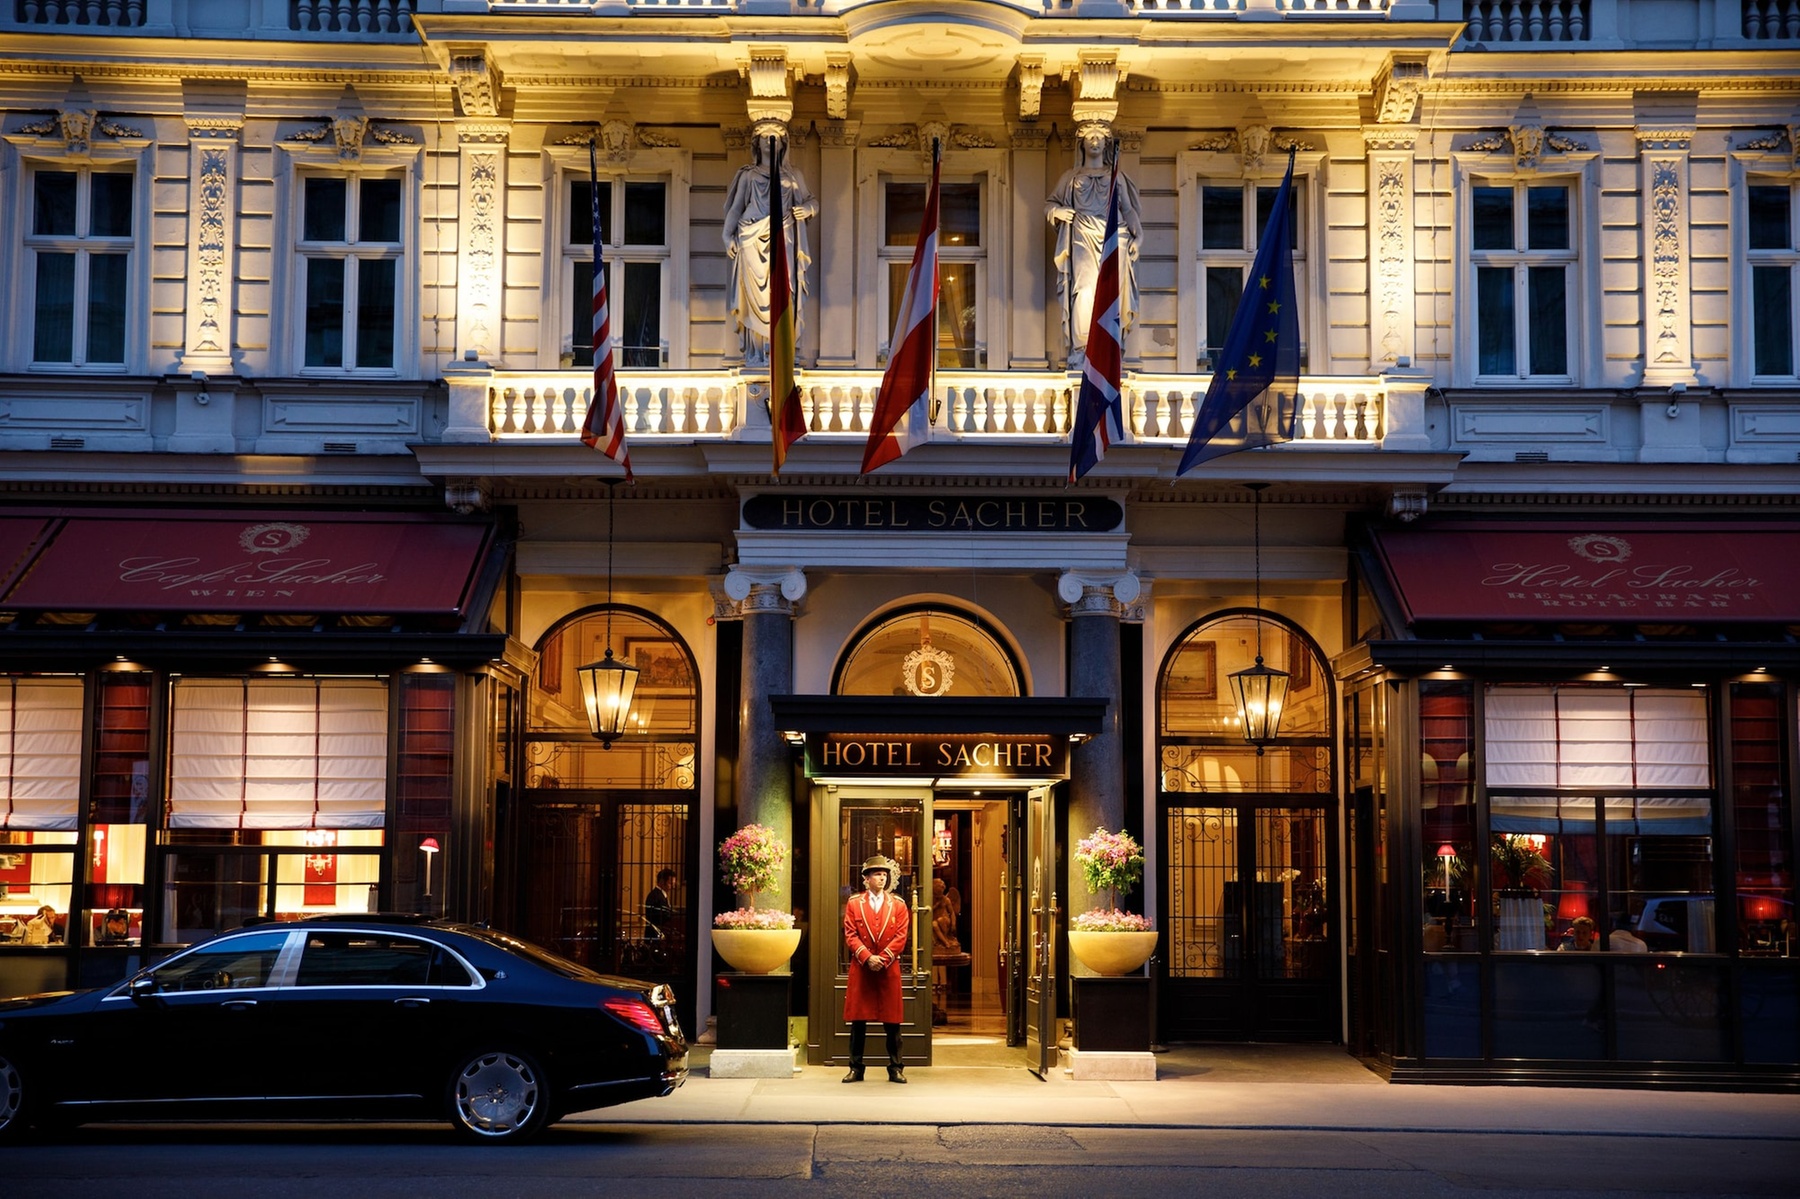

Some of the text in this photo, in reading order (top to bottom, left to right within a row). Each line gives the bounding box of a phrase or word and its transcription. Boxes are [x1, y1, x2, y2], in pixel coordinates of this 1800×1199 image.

[781, 499, 1089, 528] HOTEL SACHER
[261, 532, 282, 546] S
[1592, 543, 1612, 556] S
[118, 556, 388, 590] Café Sacher
[1481, 562, 1765, 590] Hotel Sacher
[190, 589, 297, 598] WIEN
[1506, 592, 1757, 601] RESTAURANT
[1541, 599, 1731, 608] ROTE BAR
[921, 666, 936, 689] S
[823, 742, 1053, 768] HOTEL SACHER
